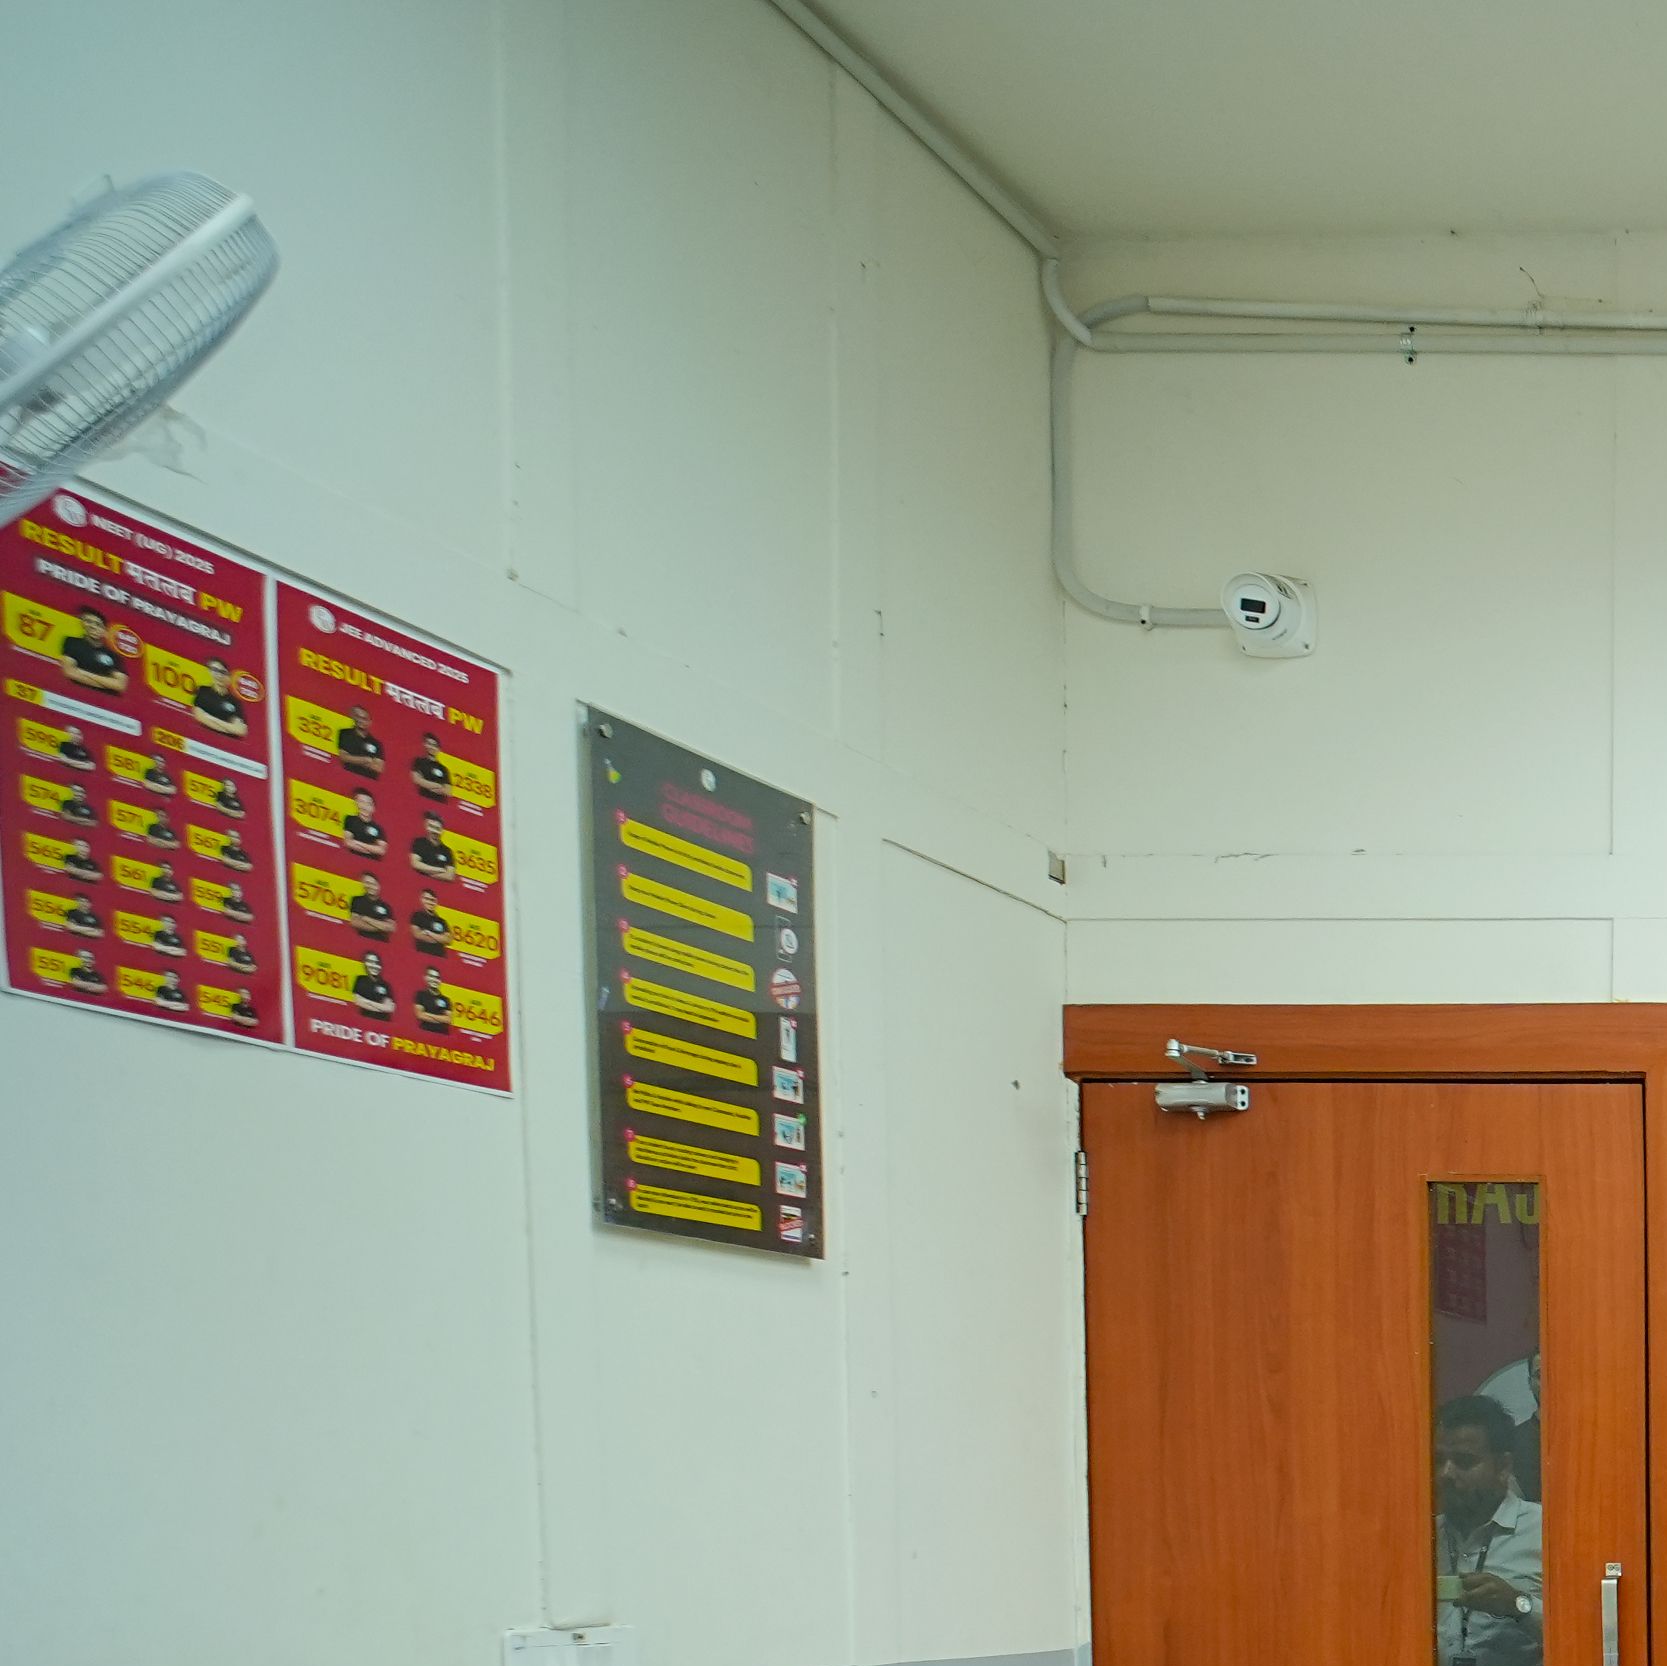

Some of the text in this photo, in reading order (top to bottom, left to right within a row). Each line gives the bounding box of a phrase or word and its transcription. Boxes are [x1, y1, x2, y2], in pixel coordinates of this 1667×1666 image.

[19, 518, 124, 575] RESULT
[199, 592, 244, 624] PW
[36, 556, 101, 596] PRIDE
[101, 582, 132, 605] OF
[131, 595, 232, 646] PRAYAGRAJ
[19, 612, 55, 642] 87
[364, 632, 438, 671] ADVANCED
[152, 662, 197, 693] 100
[299, 646, 384, 696] RESULT
[448, 706, 485, 736] PW
[296, 715, 335, 744] 332
[452, 772, 495, 800] 2338
[294, 798, 342, 826] 3074
[298, 881, 350, 911] 5706
[452, 925, 498, 951] 8620
[300, 964, 350, 992] 9081
[454, 1001, 502, 1028] 9646
[309, 1018, 497, 1073] PRIDE OF PRAYAGRAJ
